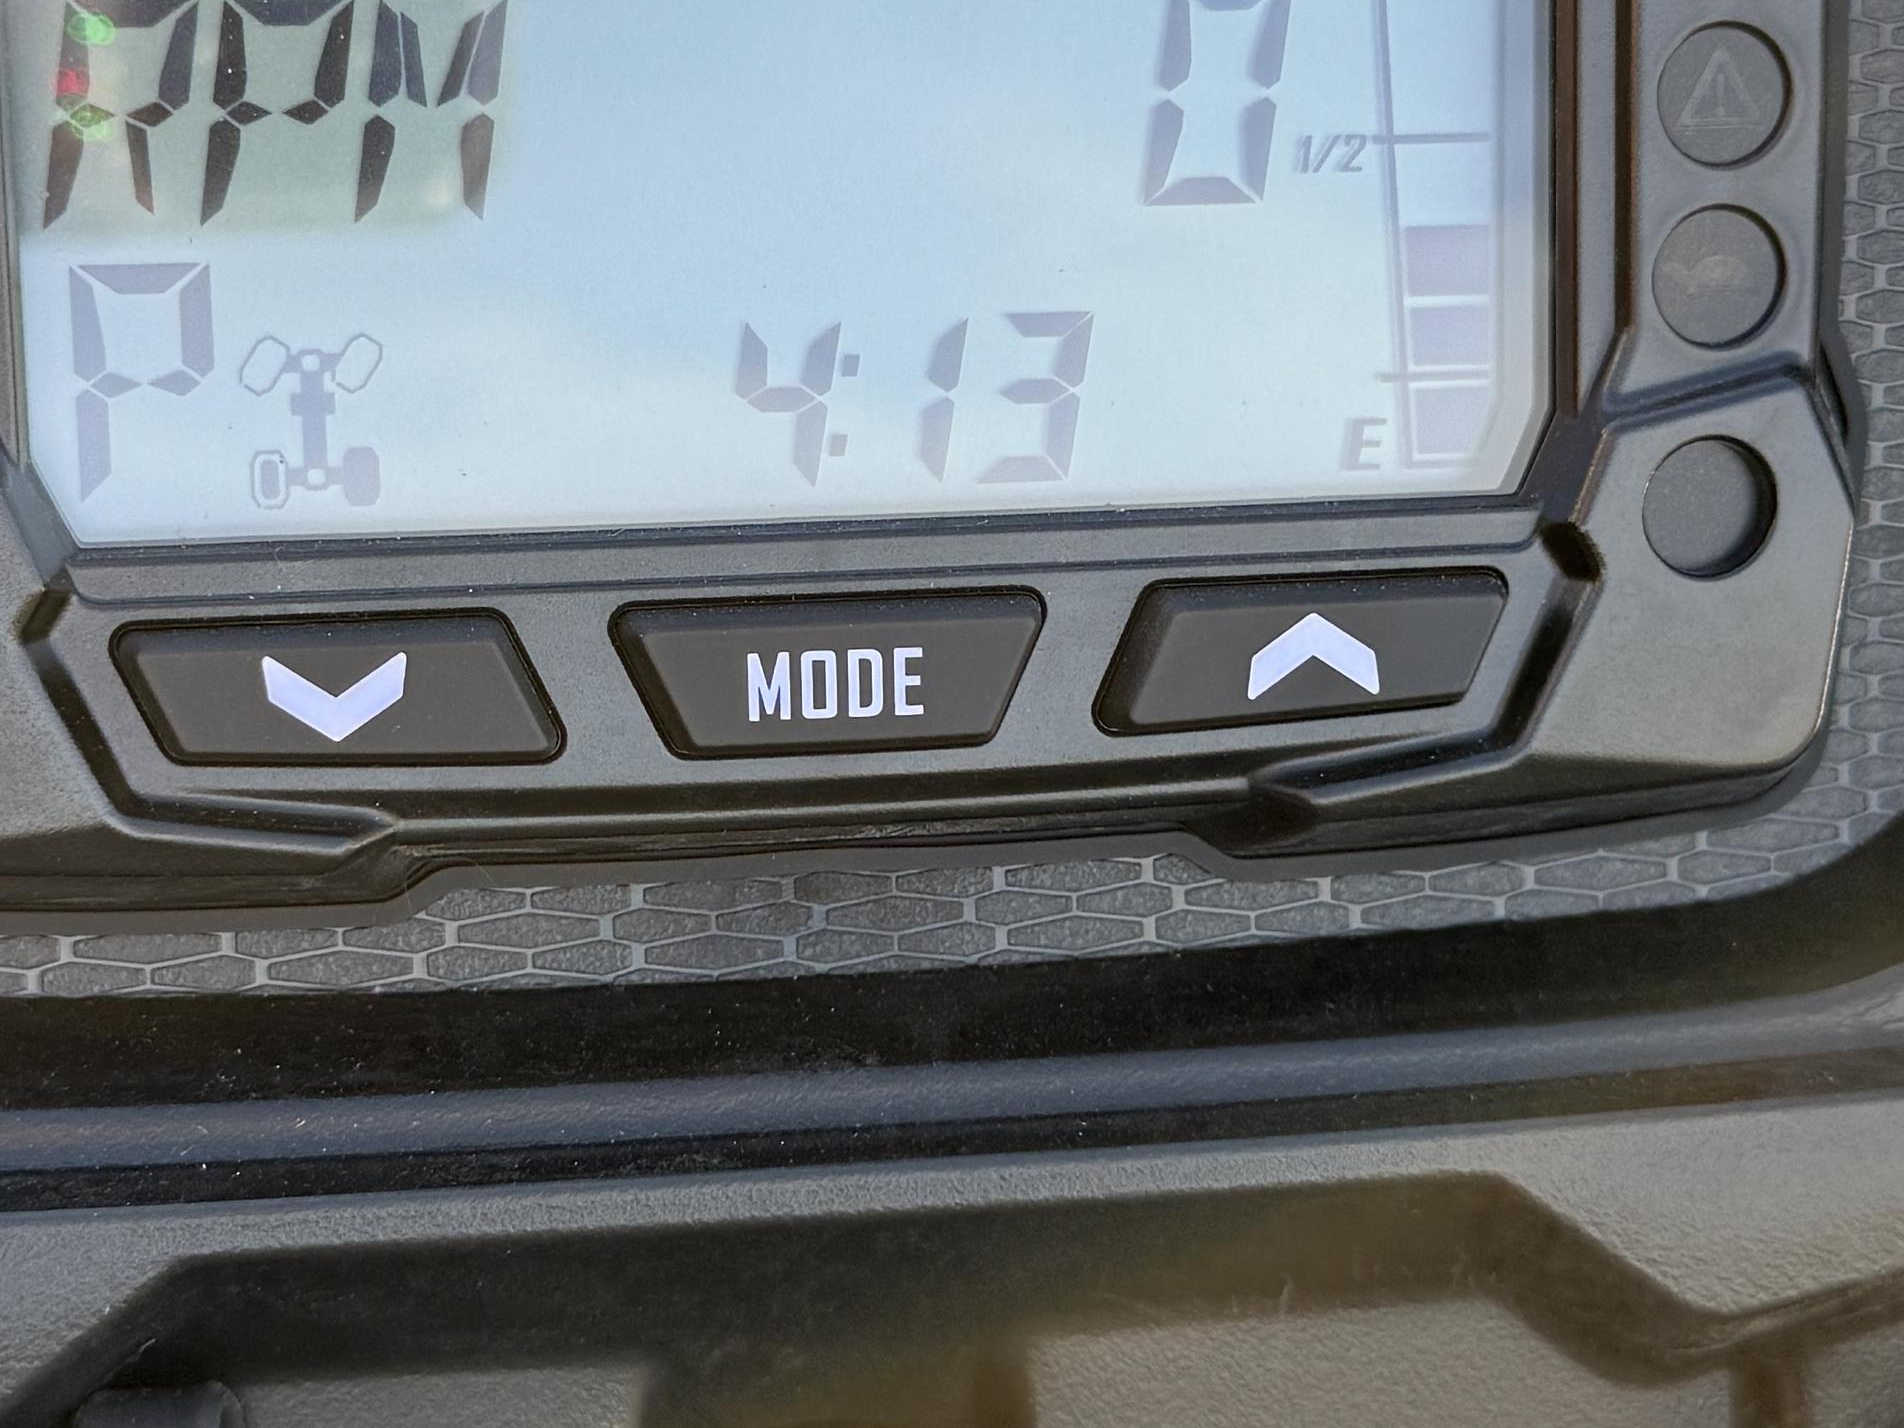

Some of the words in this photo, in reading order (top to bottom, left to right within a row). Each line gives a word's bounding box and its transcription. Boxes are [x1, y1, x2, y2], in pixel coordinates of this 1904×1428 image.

[1298, 132, 1368, 174] 1/2
[67, 262, 216, 505] P
[734, 310, 1096, 488] 4:13
[1343, 416, 1388, 472] E
[746, 646, 925, 722] MODE
